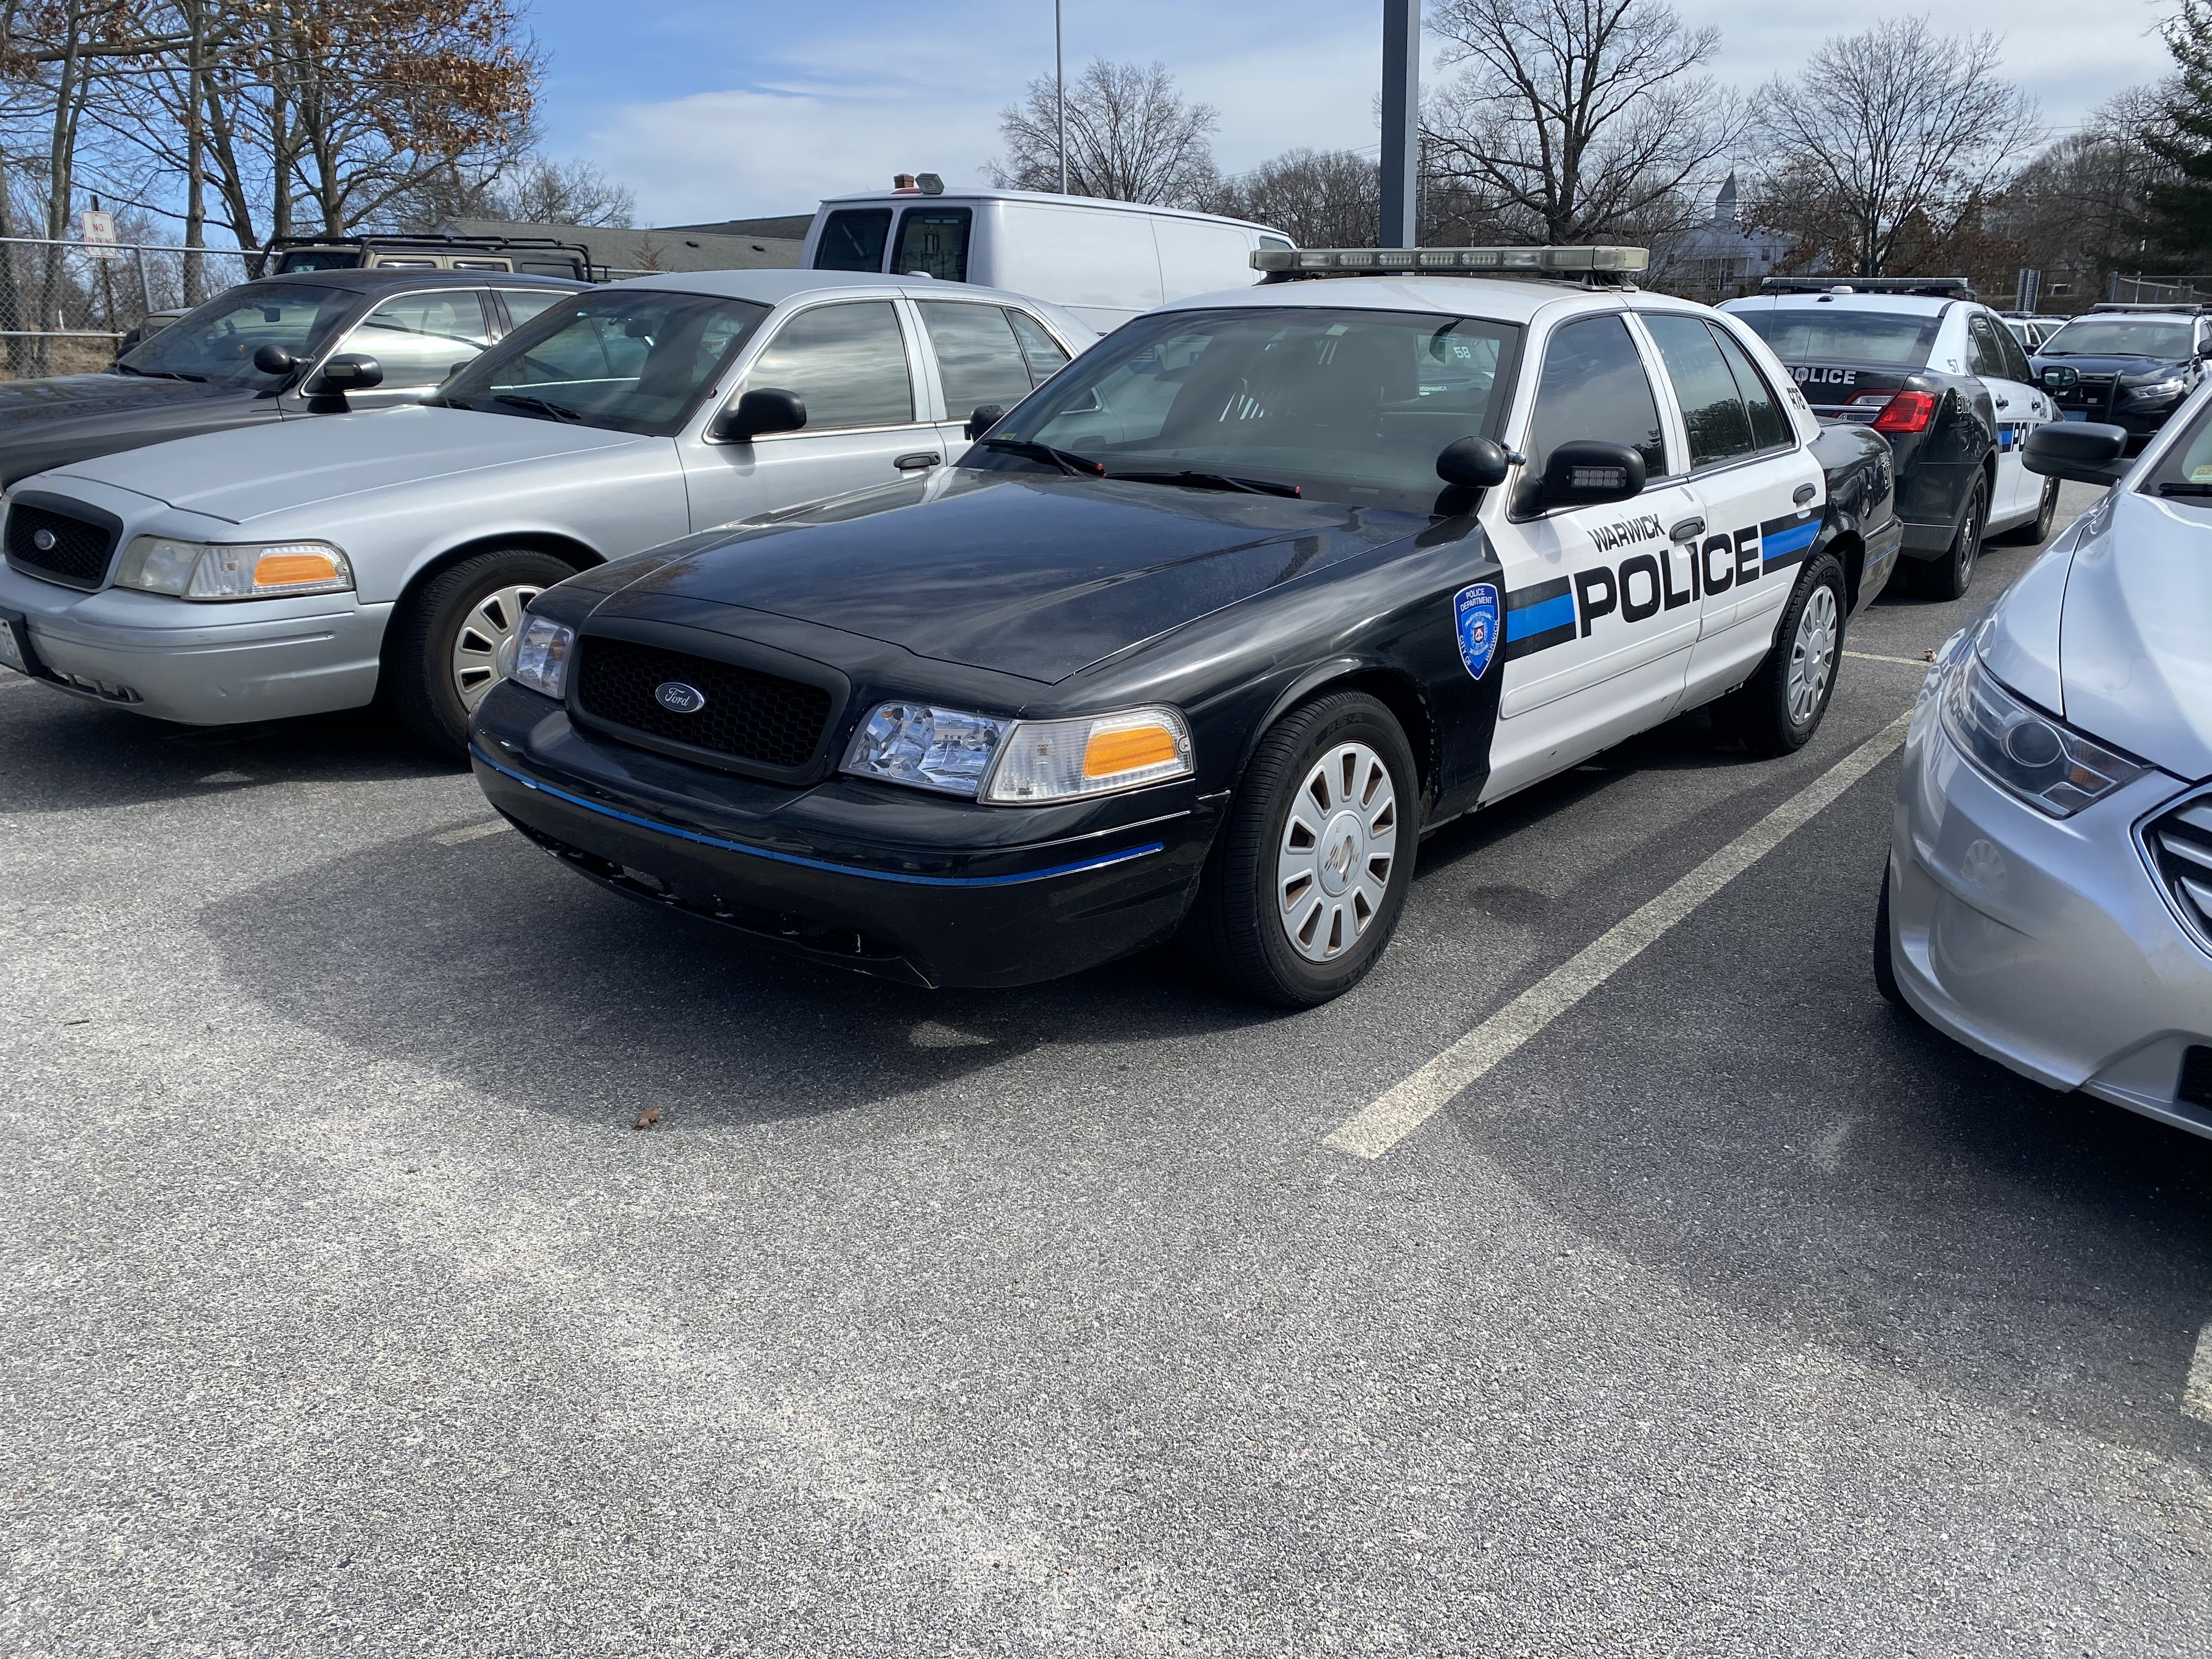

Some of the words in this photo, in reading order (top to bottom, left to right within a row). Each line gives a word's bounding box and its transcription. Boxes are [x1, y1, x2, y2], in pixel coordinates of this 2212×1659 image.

[93, 223, 104, 232] NO
[1453, 346, 1471, 359] 58
[1947, 359, 1960, 373] 57
[1587, 514, 1666, 552] WARWICK
[1573, 524, 1760, 638] POLICE
[1465, 588, 1486, 600] POLICE
[1460, 596, 1493, 612] DEPARTMENT
[1459, 635, 1467, 656] CITY
[1464, 655, 1472, 666] OF
[1485, 619, 1499, 662] WARWICK
[665, 687, 691, 707] Ford
